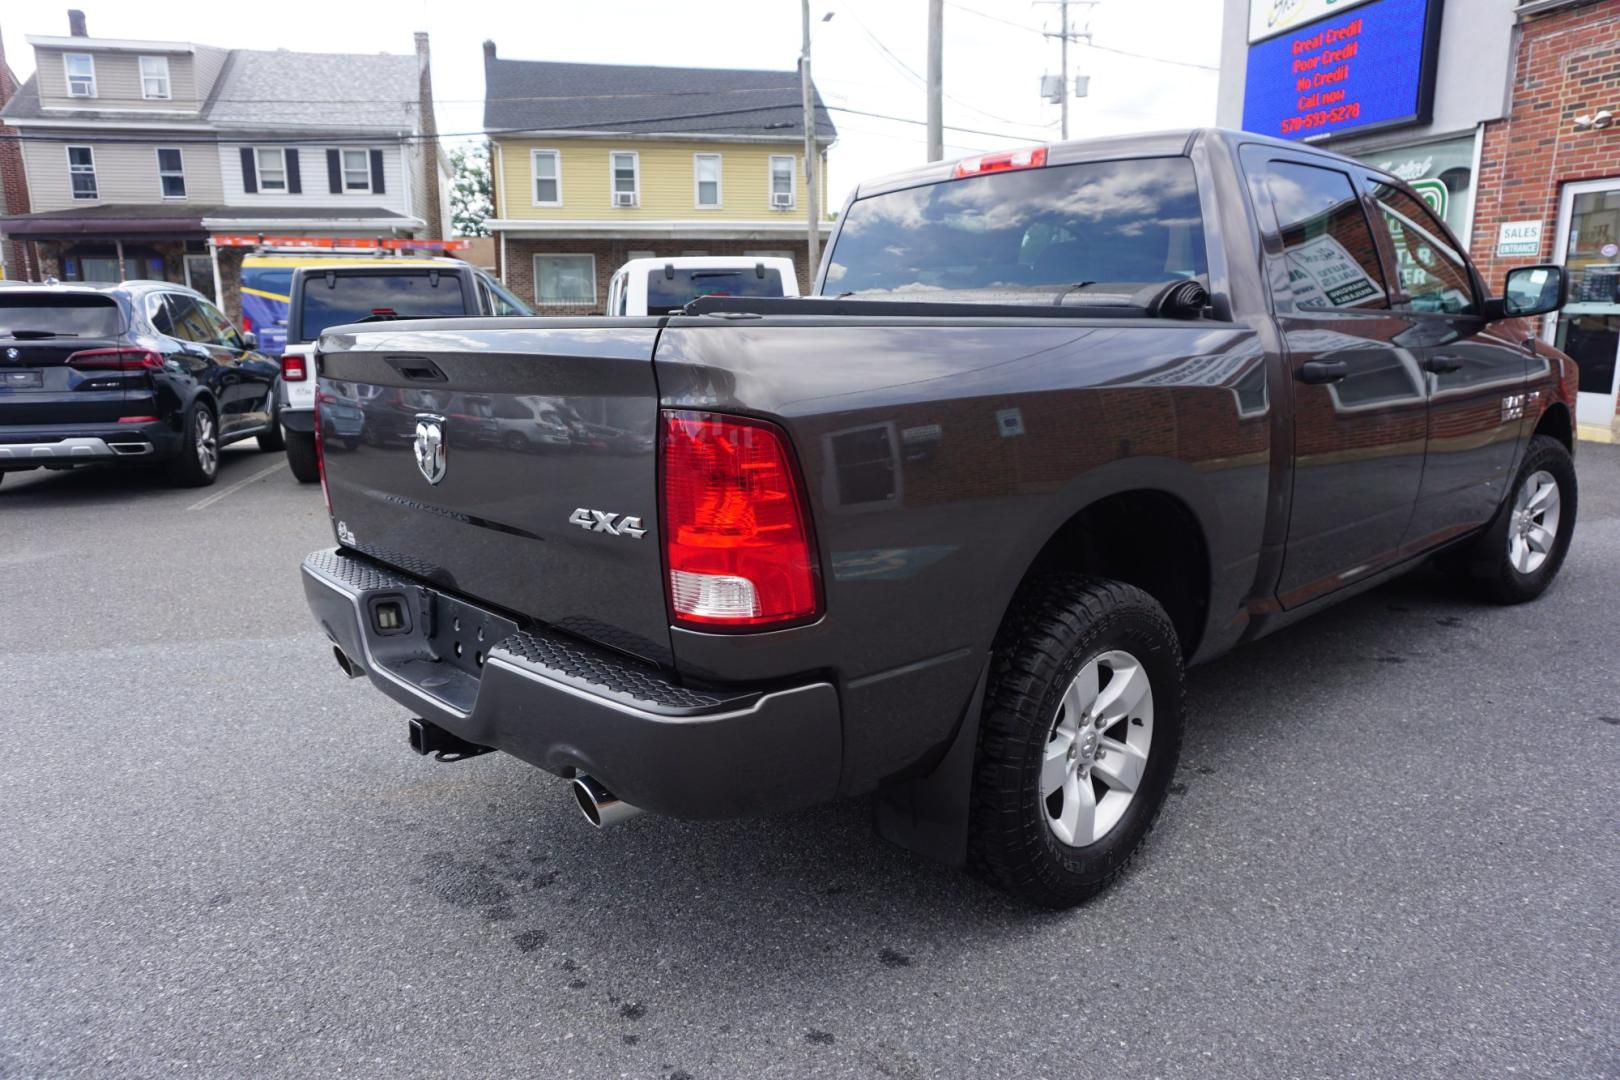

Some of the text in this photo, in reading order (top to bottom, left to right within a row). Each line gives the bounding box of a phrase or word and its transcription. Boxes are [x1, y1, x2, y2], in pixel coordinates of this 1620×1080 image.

[1292, 19, 1362, 54] Great Credit
[1292, 41, 1359, 75] Poor Credit
[1296, 64, 1349, 92] No Credit
[1297, 89, 1345, 111] Call now
[1504, 226, 1538, 239] SALES
[1502, 244, 1537, 254] ENTRANCE
